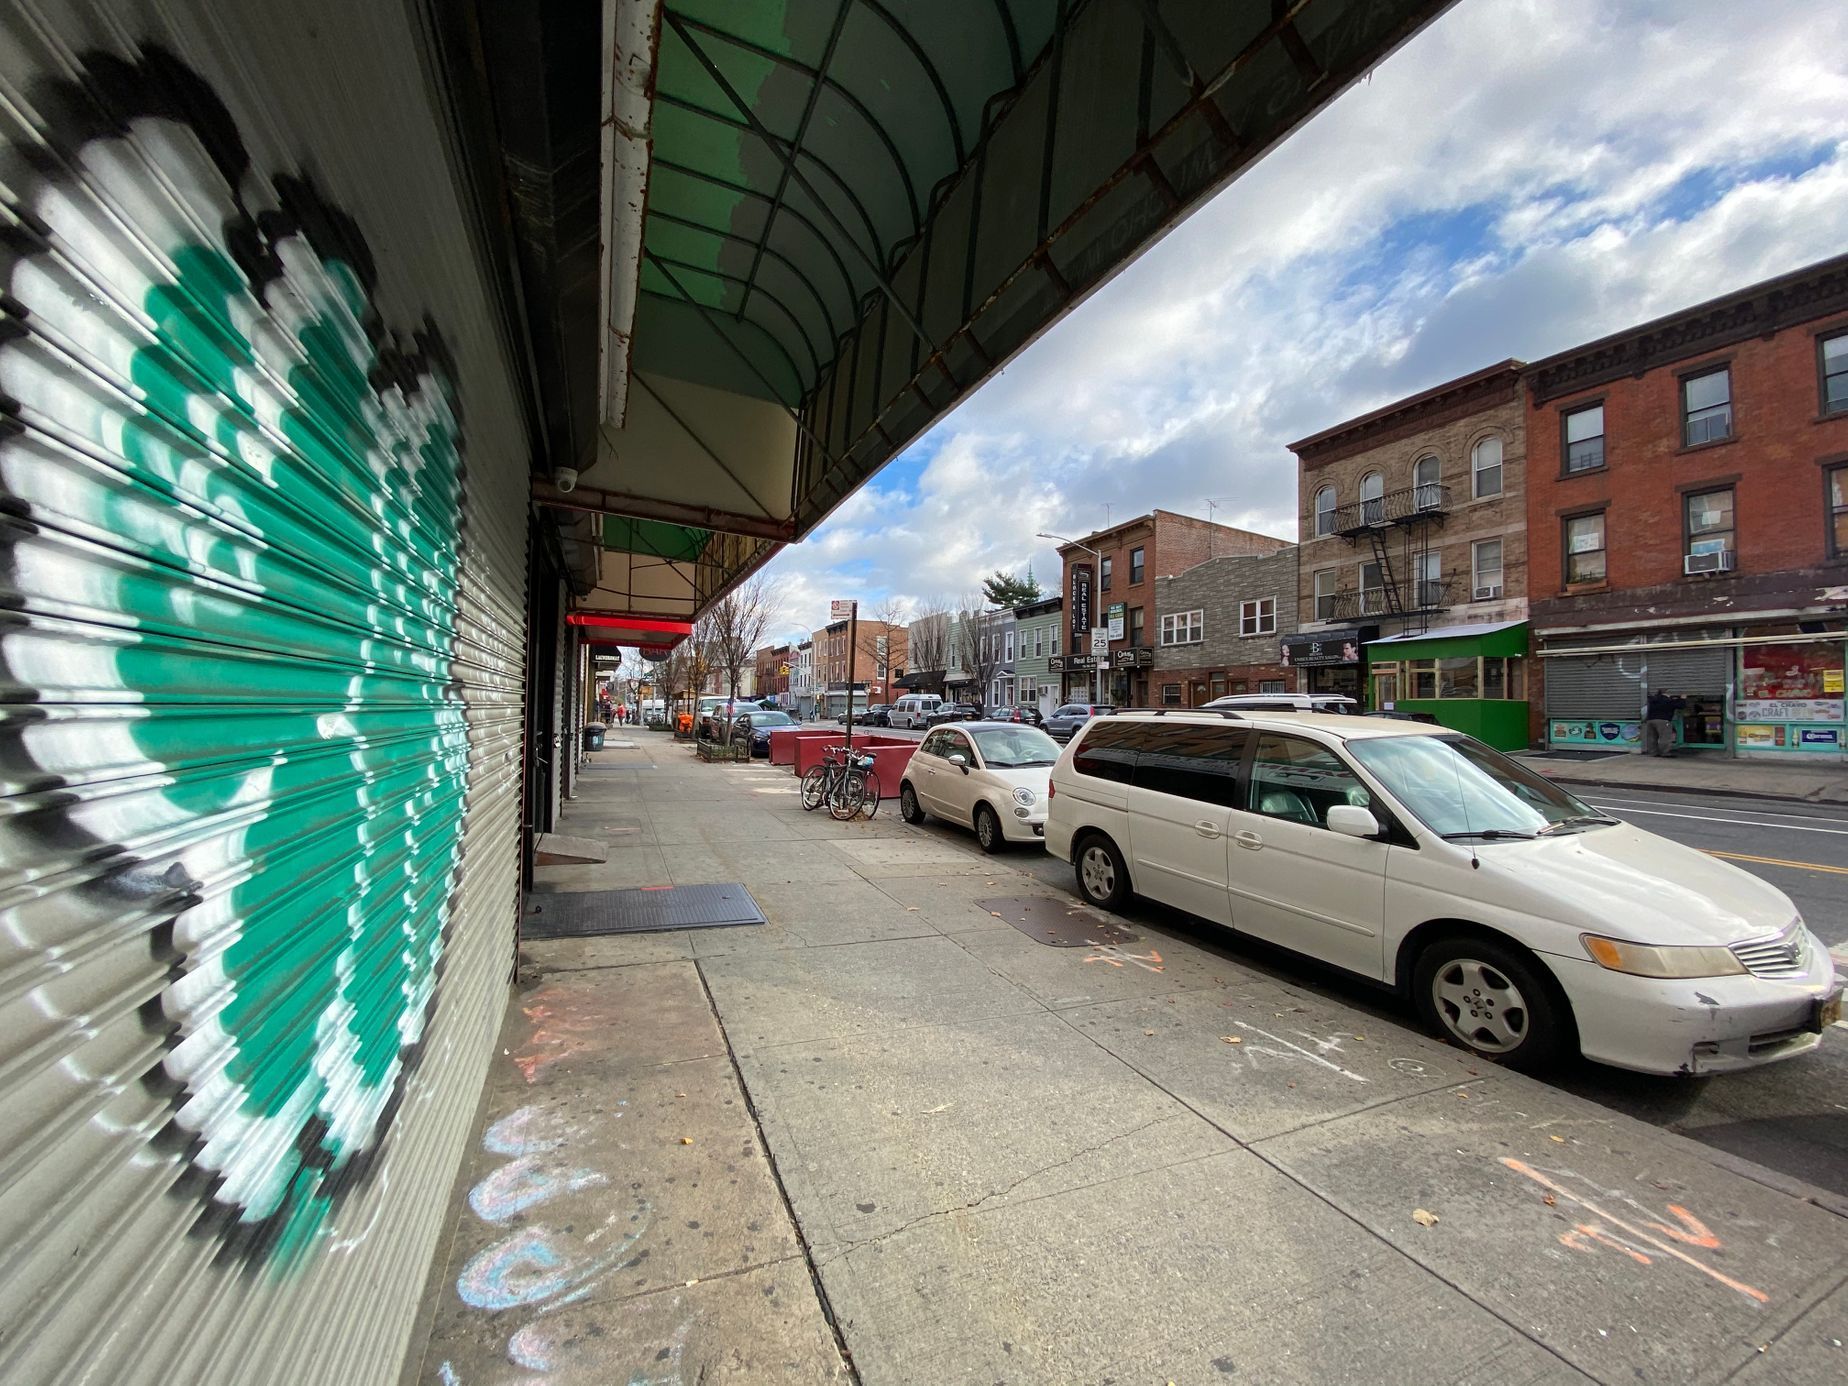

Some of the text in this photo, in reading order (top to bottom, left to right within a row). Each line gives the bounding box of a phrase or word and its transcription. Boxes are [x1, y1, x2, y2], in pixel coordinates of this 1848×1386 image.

[1094, 639, 1107, 648] 25
[1073, 657, 1085, 665] Real
[1762, 708, 1789, 718] CRAFT
